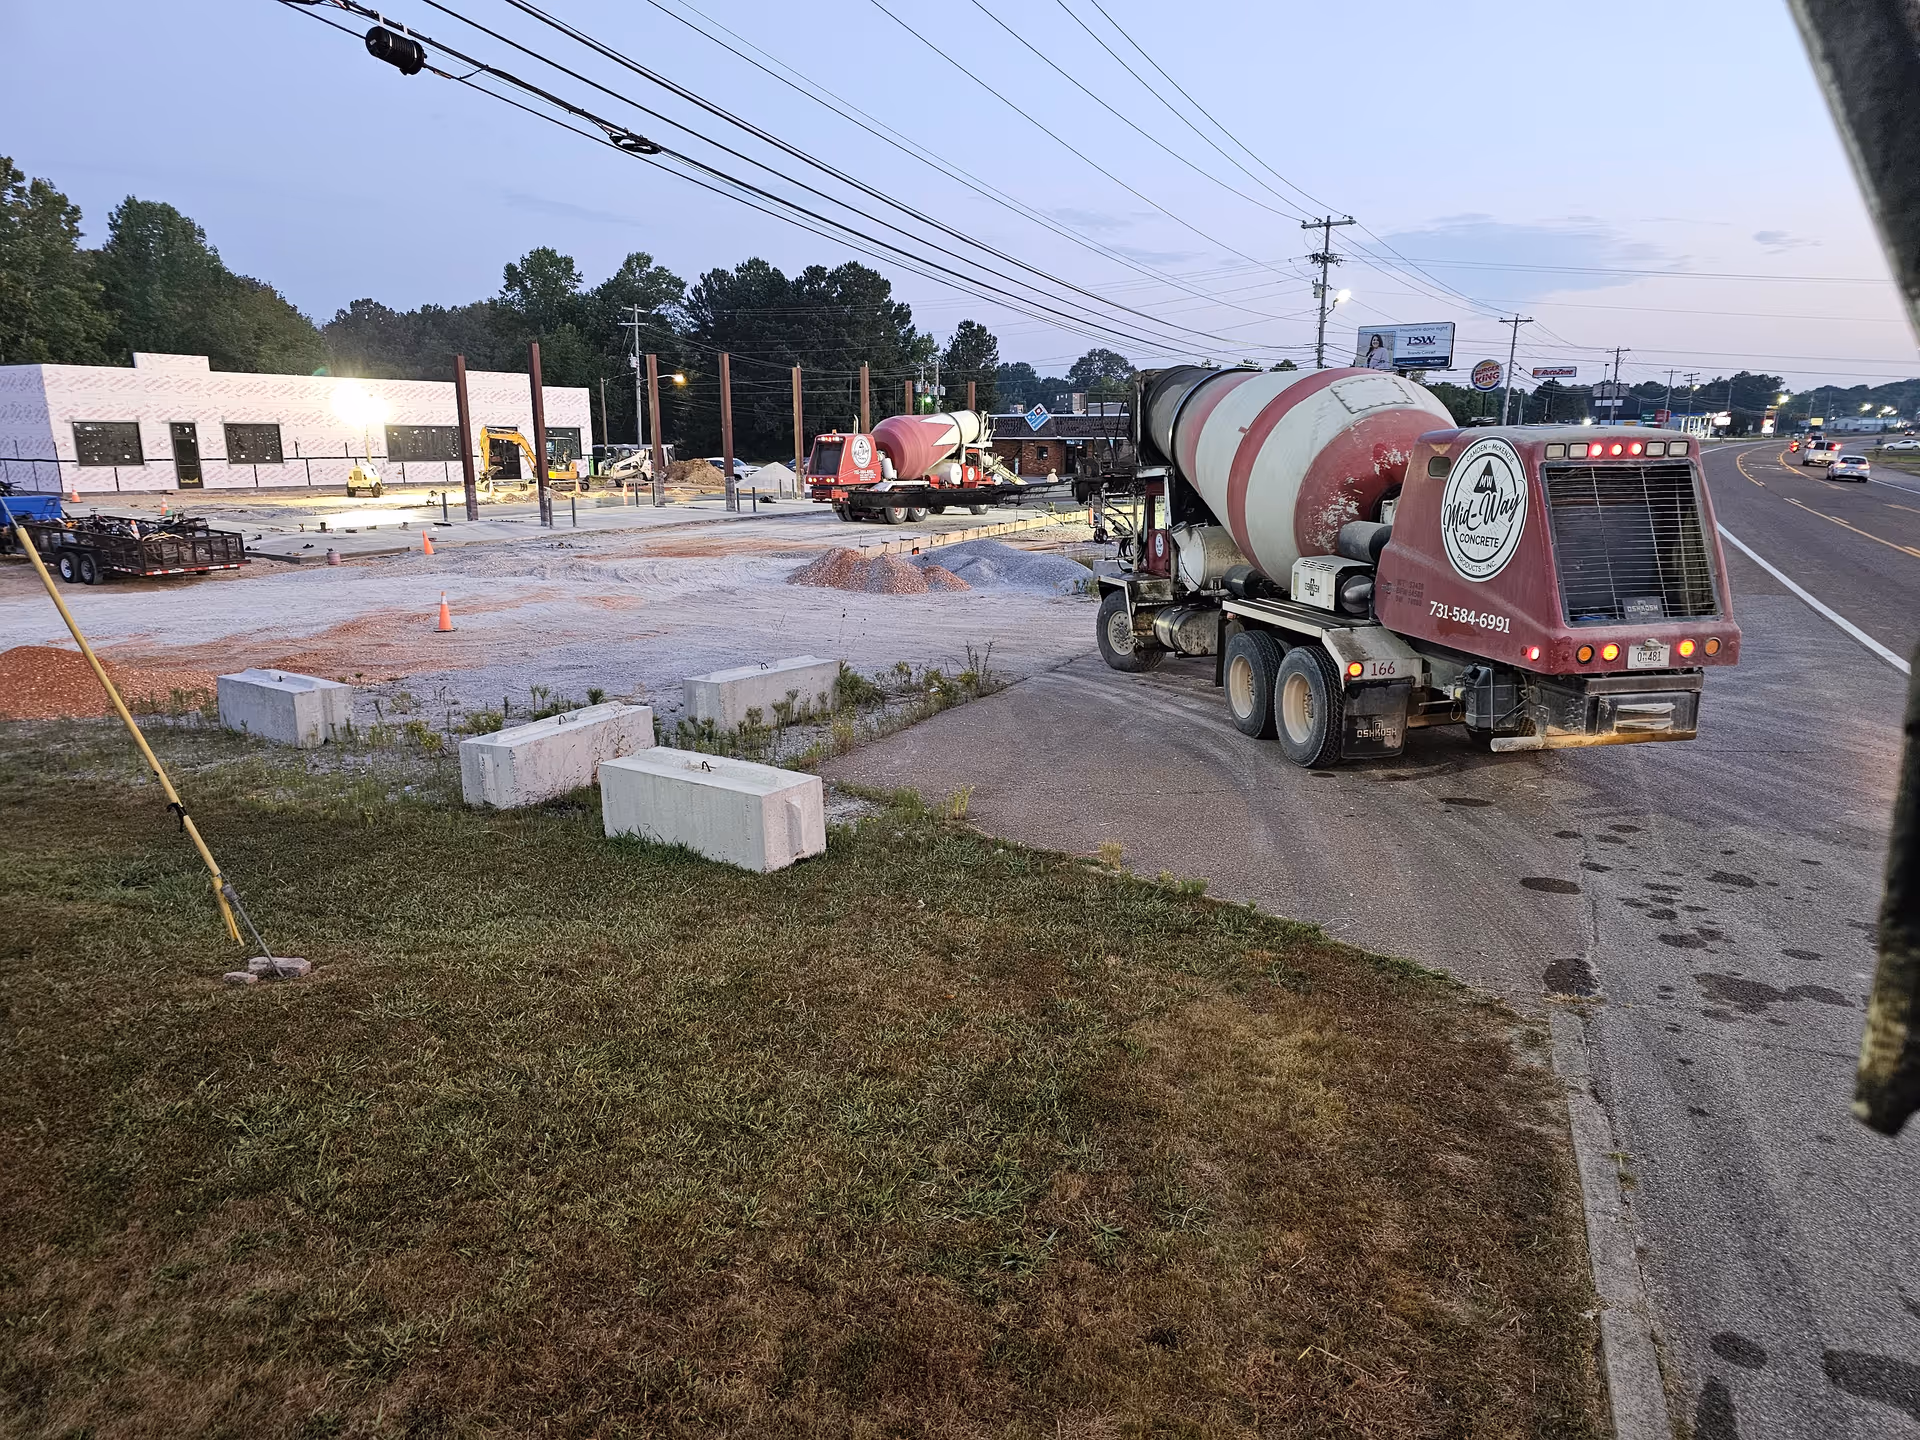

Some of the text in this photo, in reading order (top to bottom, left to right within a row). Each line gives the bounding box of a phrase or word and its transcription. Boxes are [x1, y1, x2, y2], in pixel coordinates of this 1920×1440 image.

[1407, 335, 1436, 346] PSW
[1475, 364, 1500, 376] BURGER
[1475, 371, 1500, 384] KING
[1466, 444, 1488, 462] CAMDEN
[1478, 475, 1494, 488] MW
[1443, 480, 1527, 532] Mid-Way
[1459, 533, 1500, 548] CONCRETE
[1456, 553, 1483, 573] PRODUCTS
[1429, 600, 1510, 633] 731-584-6991
[1371, 661, 1396, 676] 166
[1356, 727, 1397, 738] OSHKOSH
